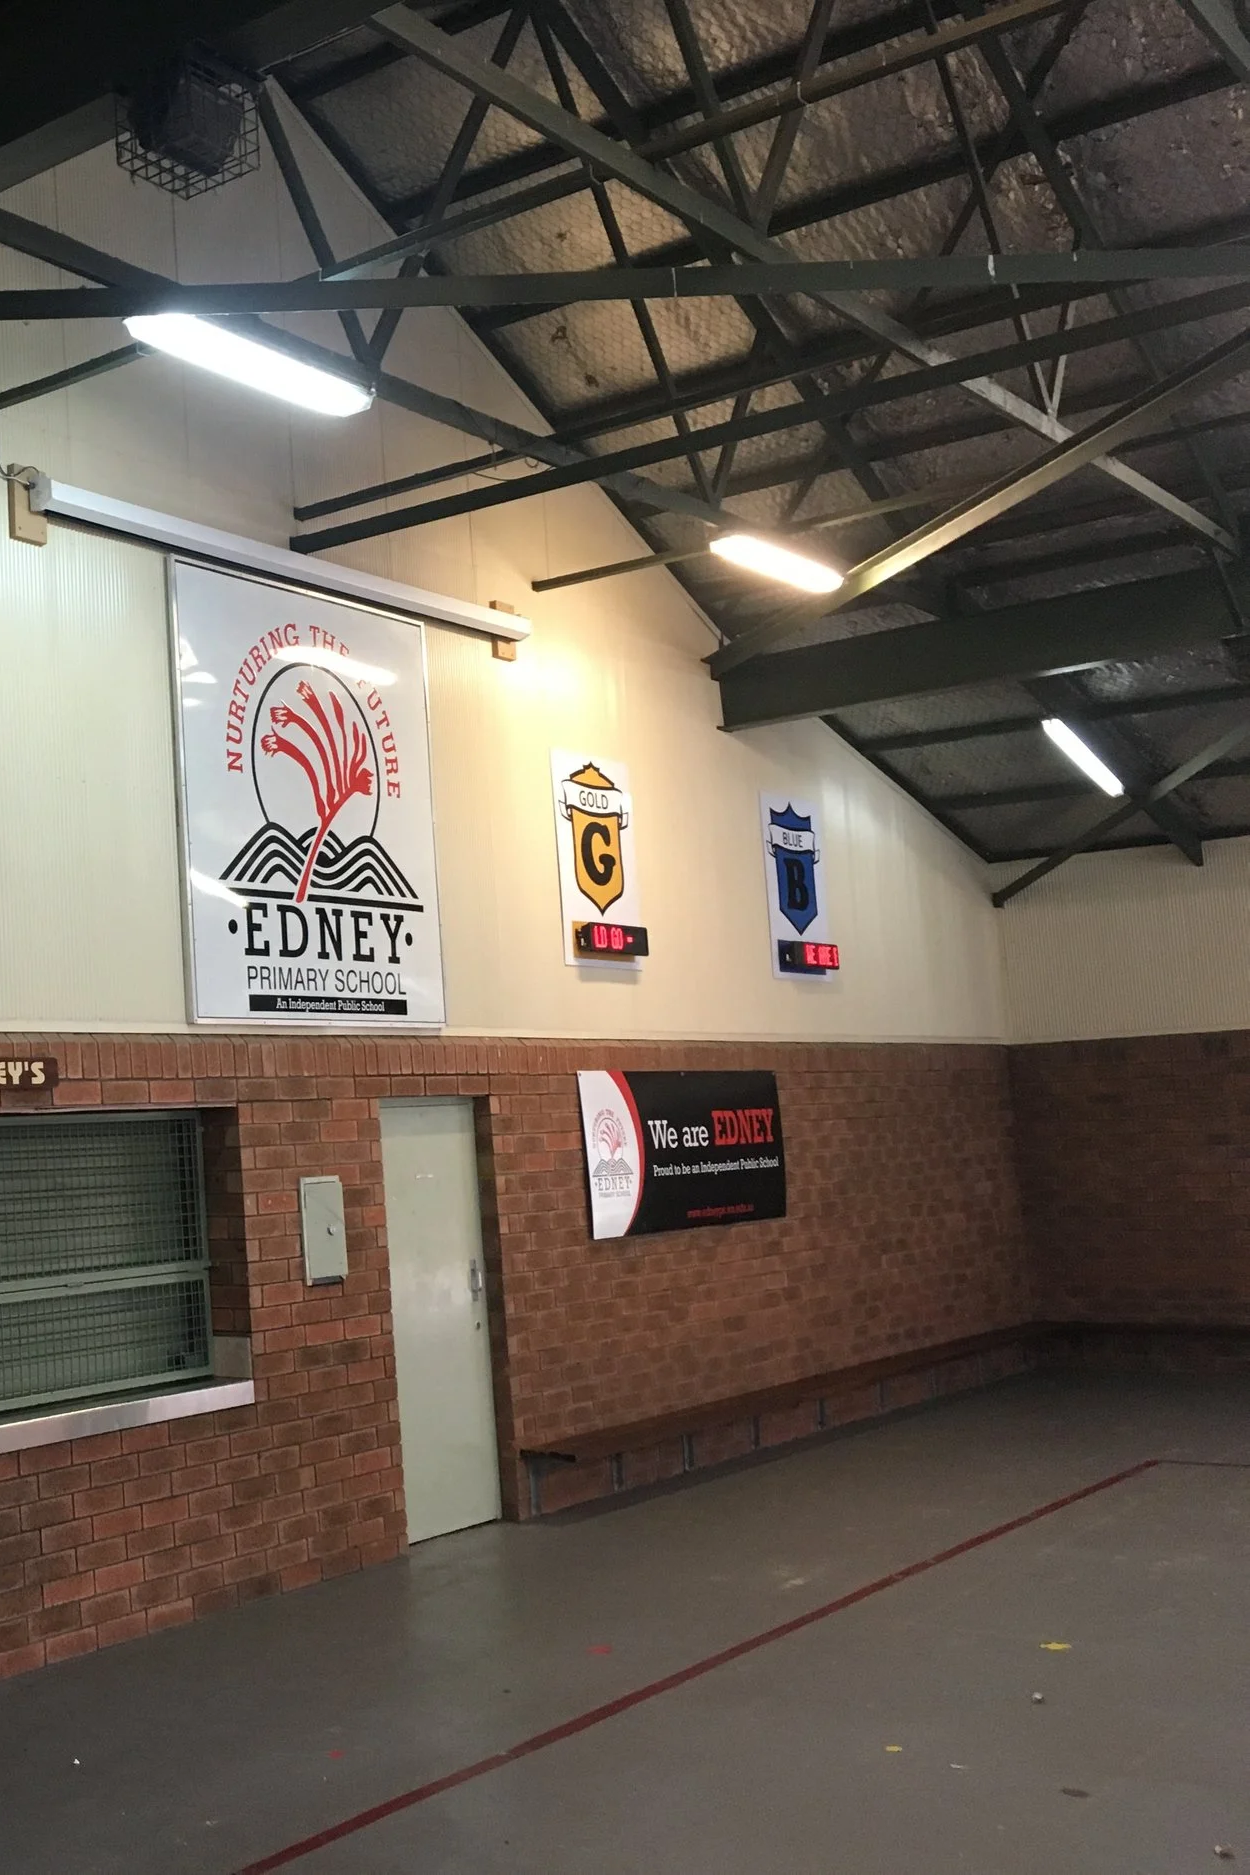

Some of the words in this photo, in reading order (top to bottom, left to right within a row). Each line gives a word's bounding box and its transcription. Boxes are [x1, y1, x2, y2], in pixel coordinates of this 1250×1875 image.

[226, 623, 300, 774] NURTURING
[578, 790, 609, 810] GOLD
[581, 821, 616, 886] G
[782, 832, 803, 848] BLUE
[783, 858, 810, 911] B
[244, 902, 405, 964] EDNEY
[247, 966, 330, 992] PRIMARY
[334, 969, 407, 995] SCHOOL
[276, 997, 288, 1009] An
[289, 998, 337, 1012] Independent
[338, 1000, 361, 1011] Public
[361, 1001, 385, 1012] School
[648, 1120, 678, 1149] We
[682, 1126, 709, 1148] are
[711, 1108, 774, 1146] EDNEY
[653, 1164, 674, 1177] Proud
[674, 1165, 681, 1175] to
[681, 1163, 691, 1175] be
[692, 1165, 700, 1174] an
[700, 1160, 740, 1175] Independent
[740, 1158, 759, 1170] Public
[759, 1156, 779, 1168] School
